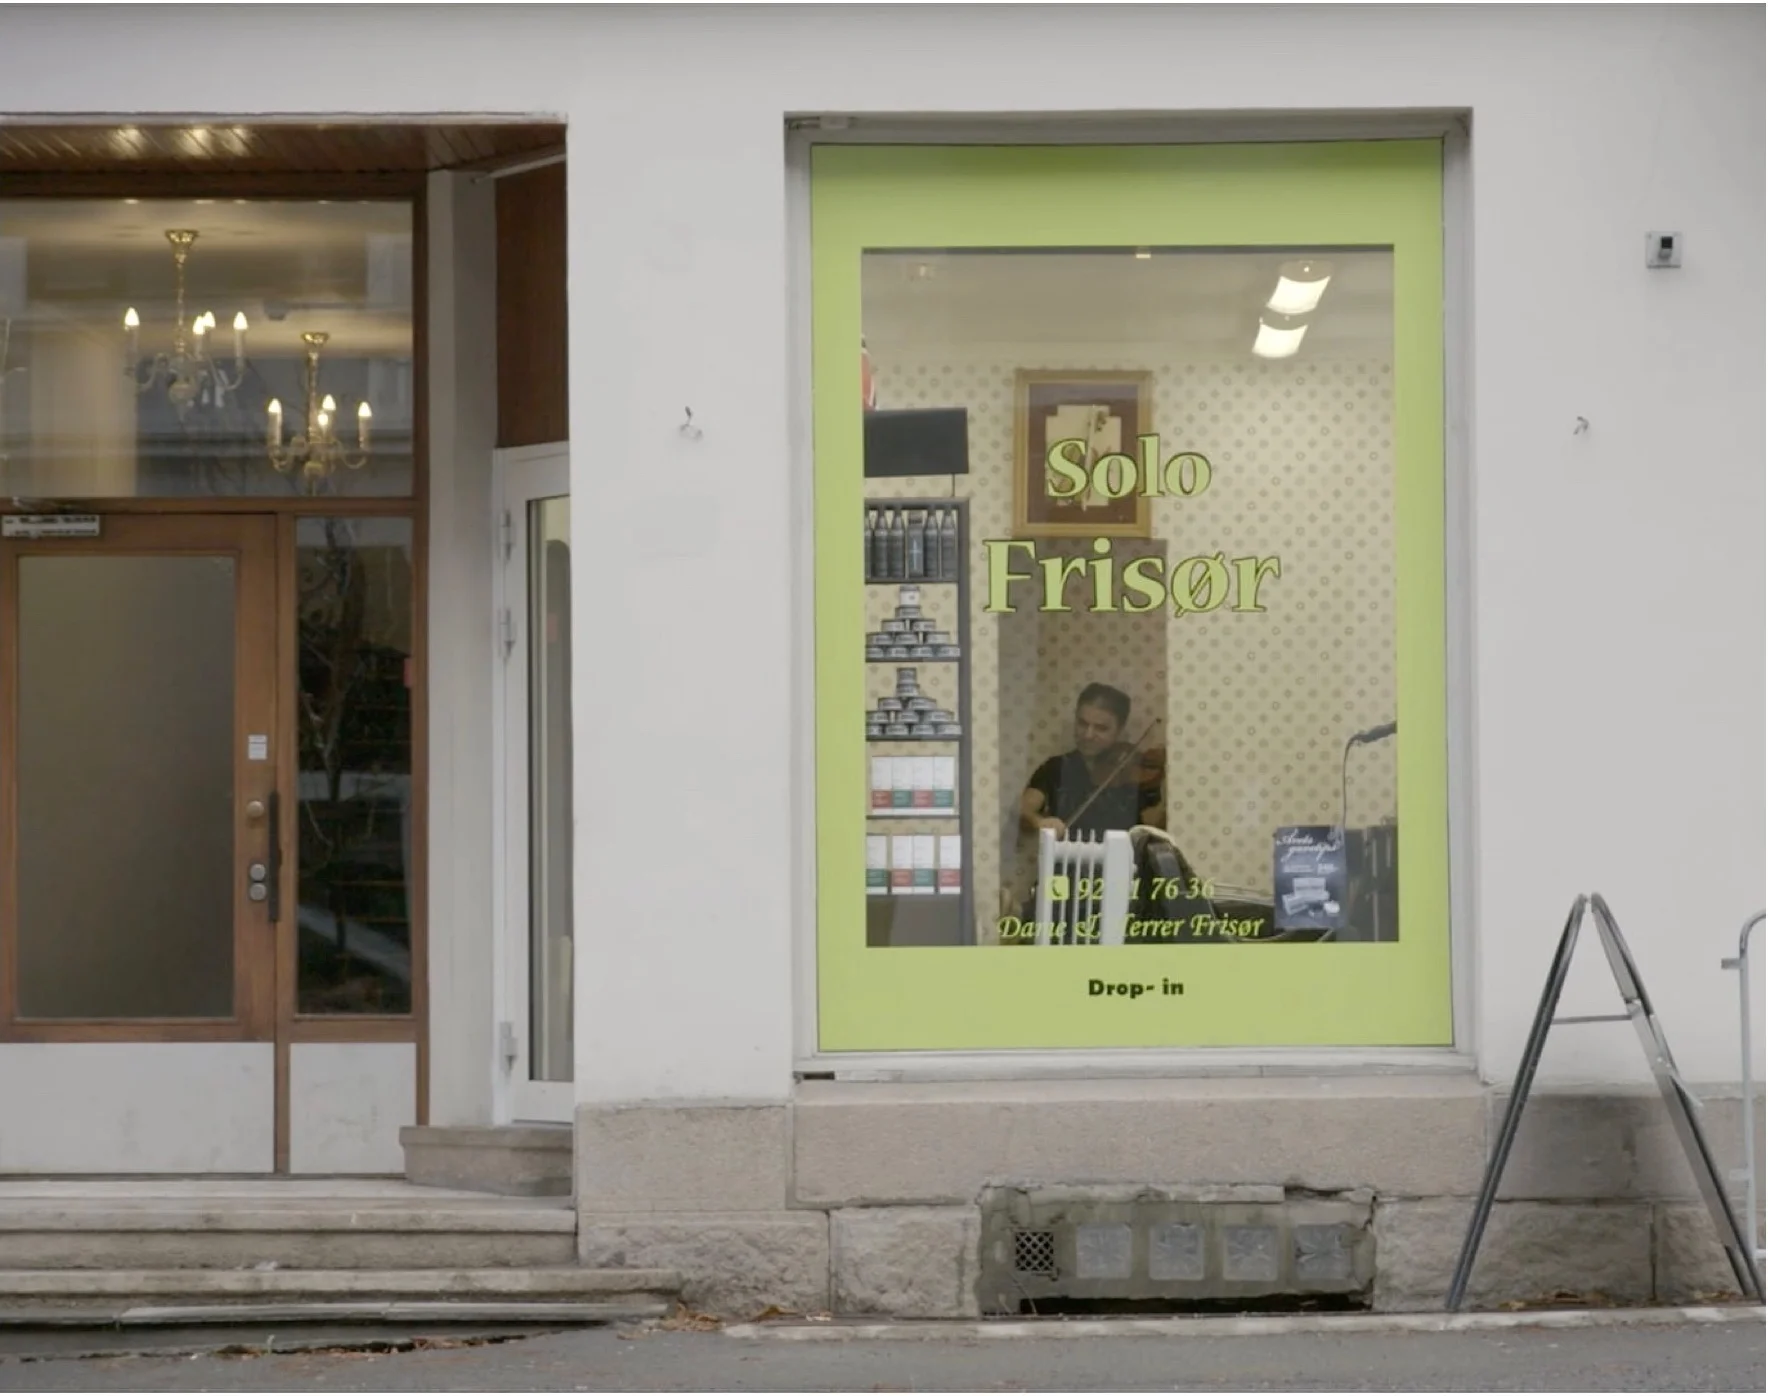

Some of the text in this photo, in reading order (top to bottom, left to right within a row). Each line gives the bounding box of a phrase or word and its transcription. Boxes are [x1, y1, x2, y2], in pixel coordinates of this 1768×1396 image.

[1047, 433, 1211, 498] Solo
[983, 537, 1281, 617] Frisør
[1078, 877, 1104, 900] 92
[1150, 877, 1180, 900] 76
[1186, 876, 1216, 899] 36
[1190, 912, 1265, 937] Frisør
[1162, 978, 1184, 995] in
